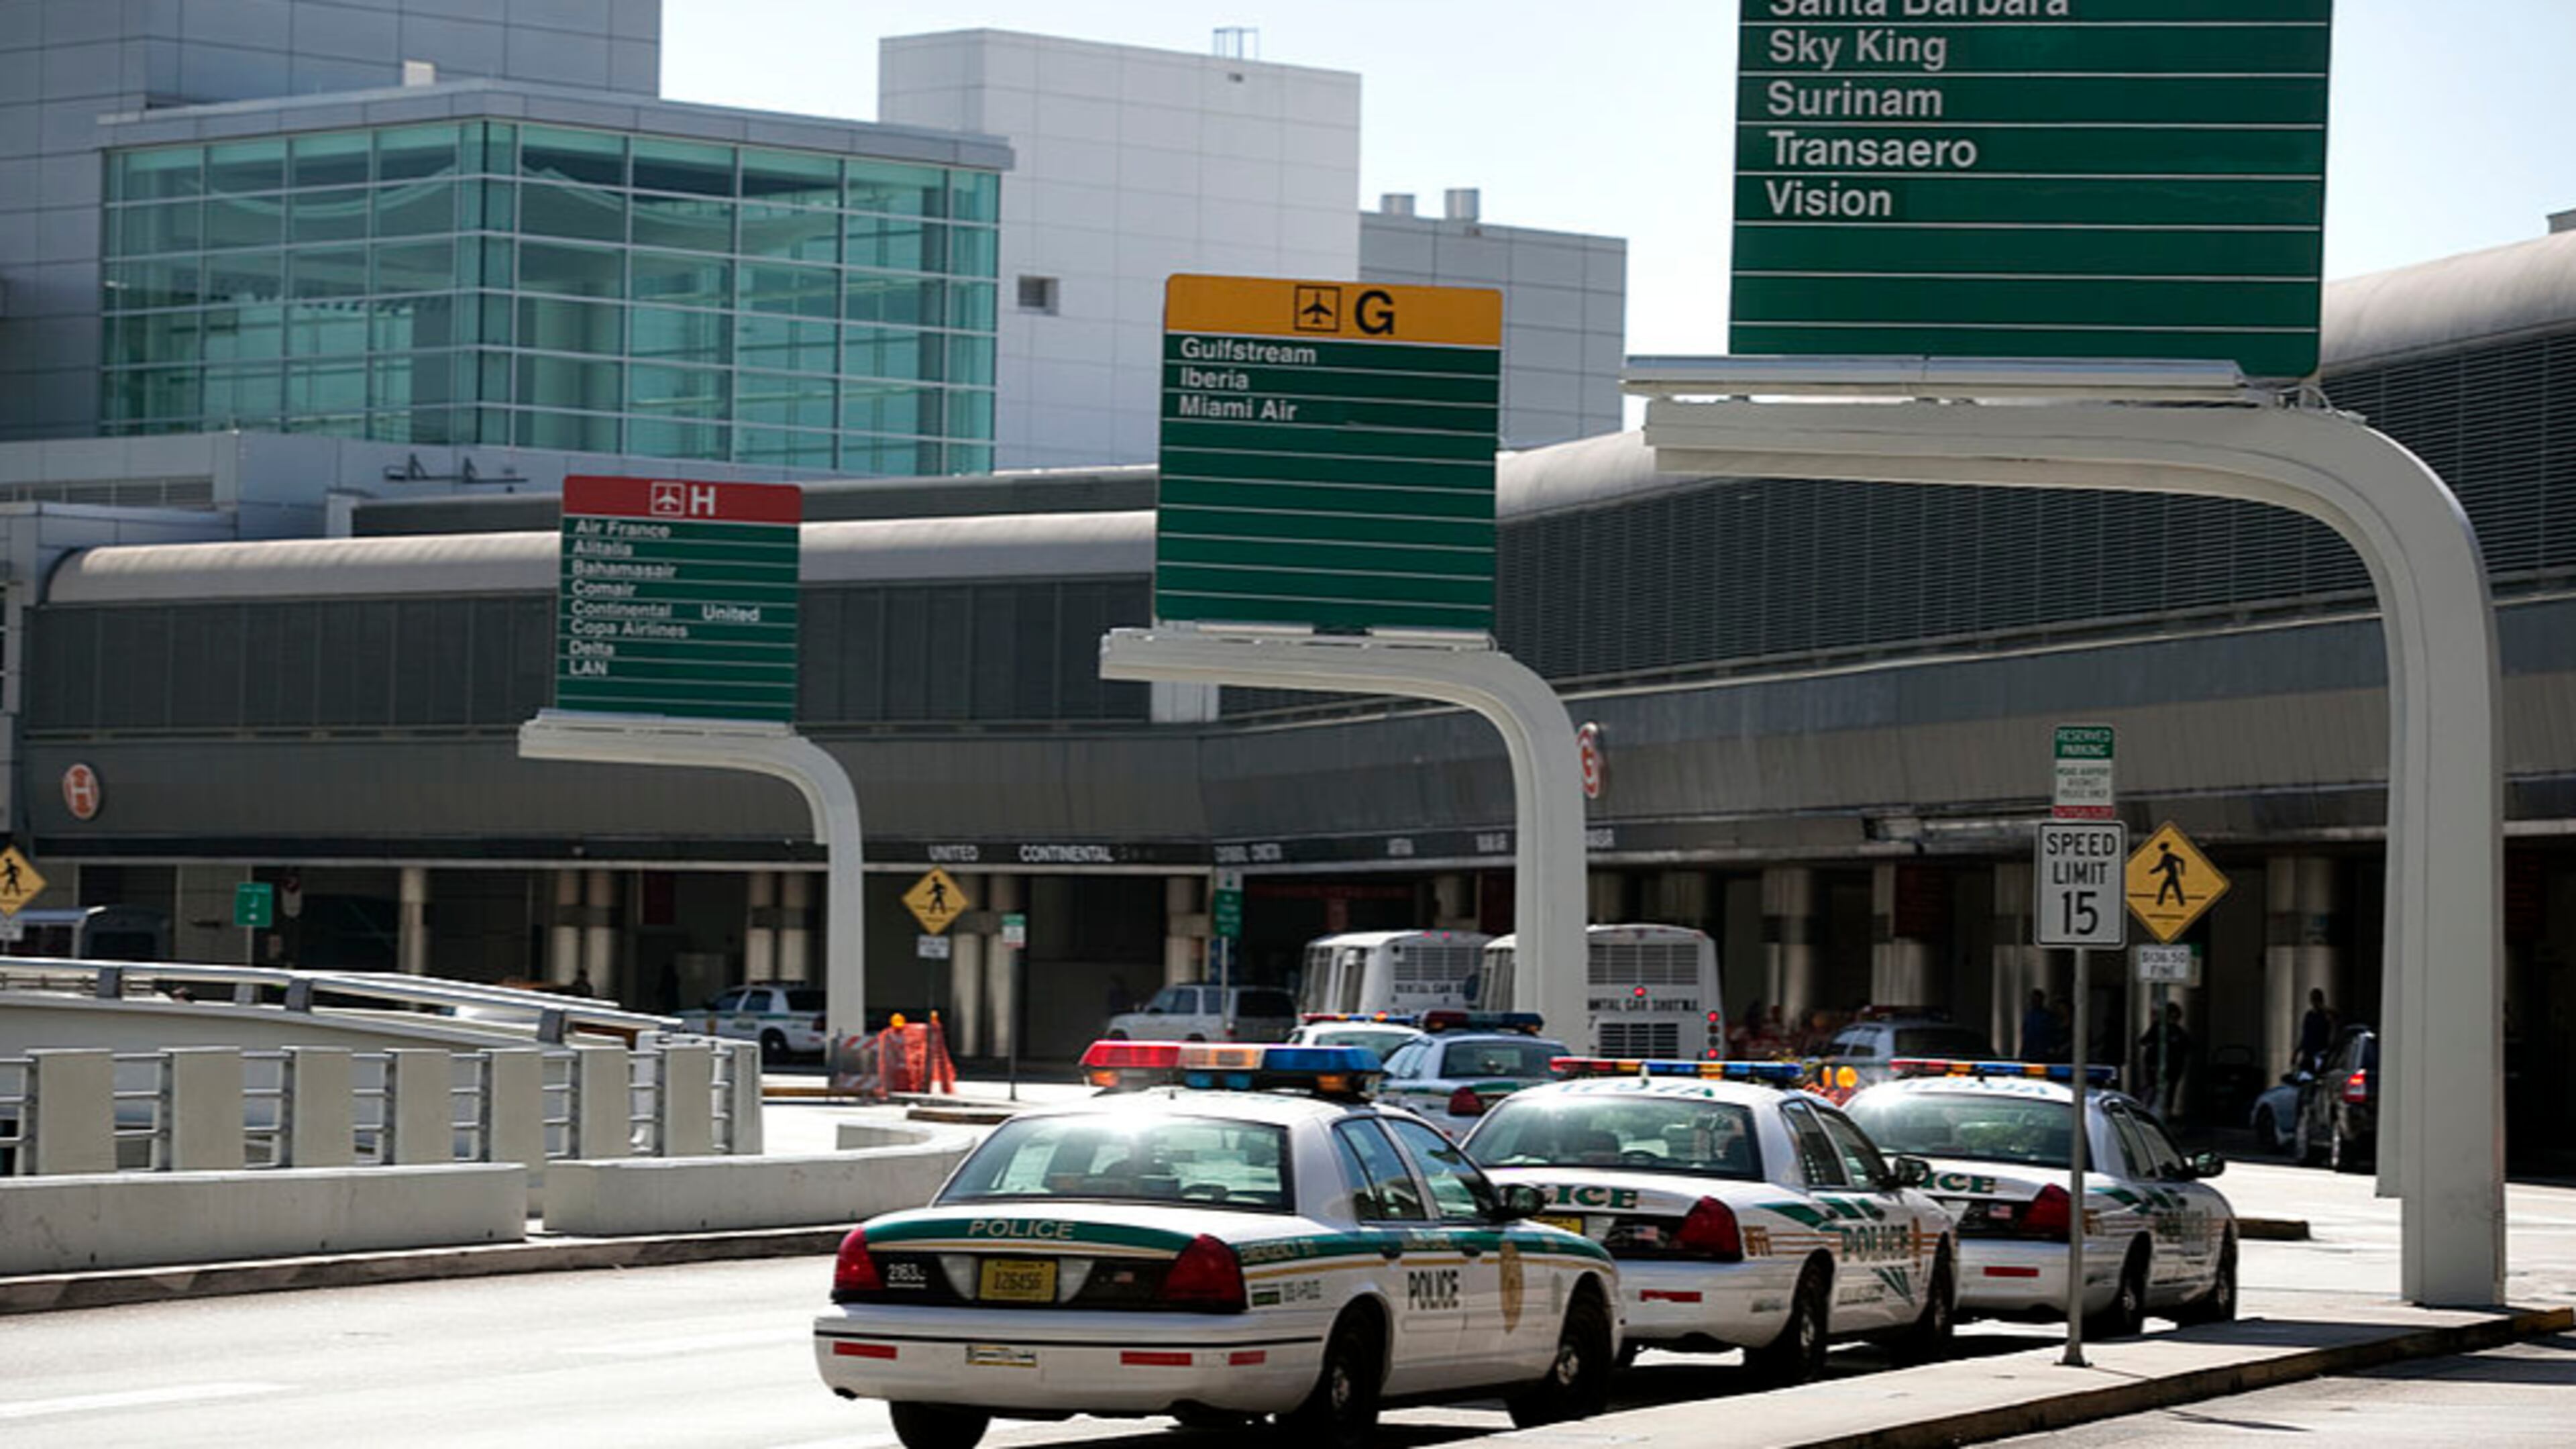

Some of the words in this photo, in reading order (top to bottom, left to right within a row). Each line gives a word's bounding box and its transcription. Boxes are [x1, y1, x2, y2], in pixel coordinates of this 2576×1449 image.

[1769, 30, 1841, 72] Sky
[1856, 29, 1947, 72] King
[1767, 81, 1943, 117] Surinam
[1768, 130, 1978, 169] Transaero
[1766, 180, 1892, 217] Vision
[1354, 290, 1395, 335] G
[1180, 337, 1316, 365] Gulfstream
[1180, 367, 1248, 390] Iberia
[1179, 396, 1253, 419] Miami
[1260, 399, 1297, 421] Air
[691, 486, 715, 515] H
[574, 521, 602, 535] Air
[607, 522, 671, 539] France
[572, 540, 633, 557] Alitalia
[572, 560, 677, 578] Bahamasair
[572, 580, 637, 597] Comair
[571, 600, 672, 618] Continental
[702, 605, 760, 623] United
[570, 620, 616, 638] Copa
[622, 623, 688, 639] Airlines
[569, 640, 614, 657] Delta
[569, 660, 608, 676] LAN
[70, 767, 95, 816] H
[927, 844, 979, 862] UNITED
[1019, 844, 1114, 863] CONTINENTAL
[2046, 833, 2116, 857] SPEED
[2052, 861, 2108, 885] LIMIT
[2061, 891, 2098, 935] 15
[967, 1219, 1076, 1240] POLICE
[1841, 1225, 1909, 1262] POLICE
[1407, 1269, 1460, 1310] POLICE
